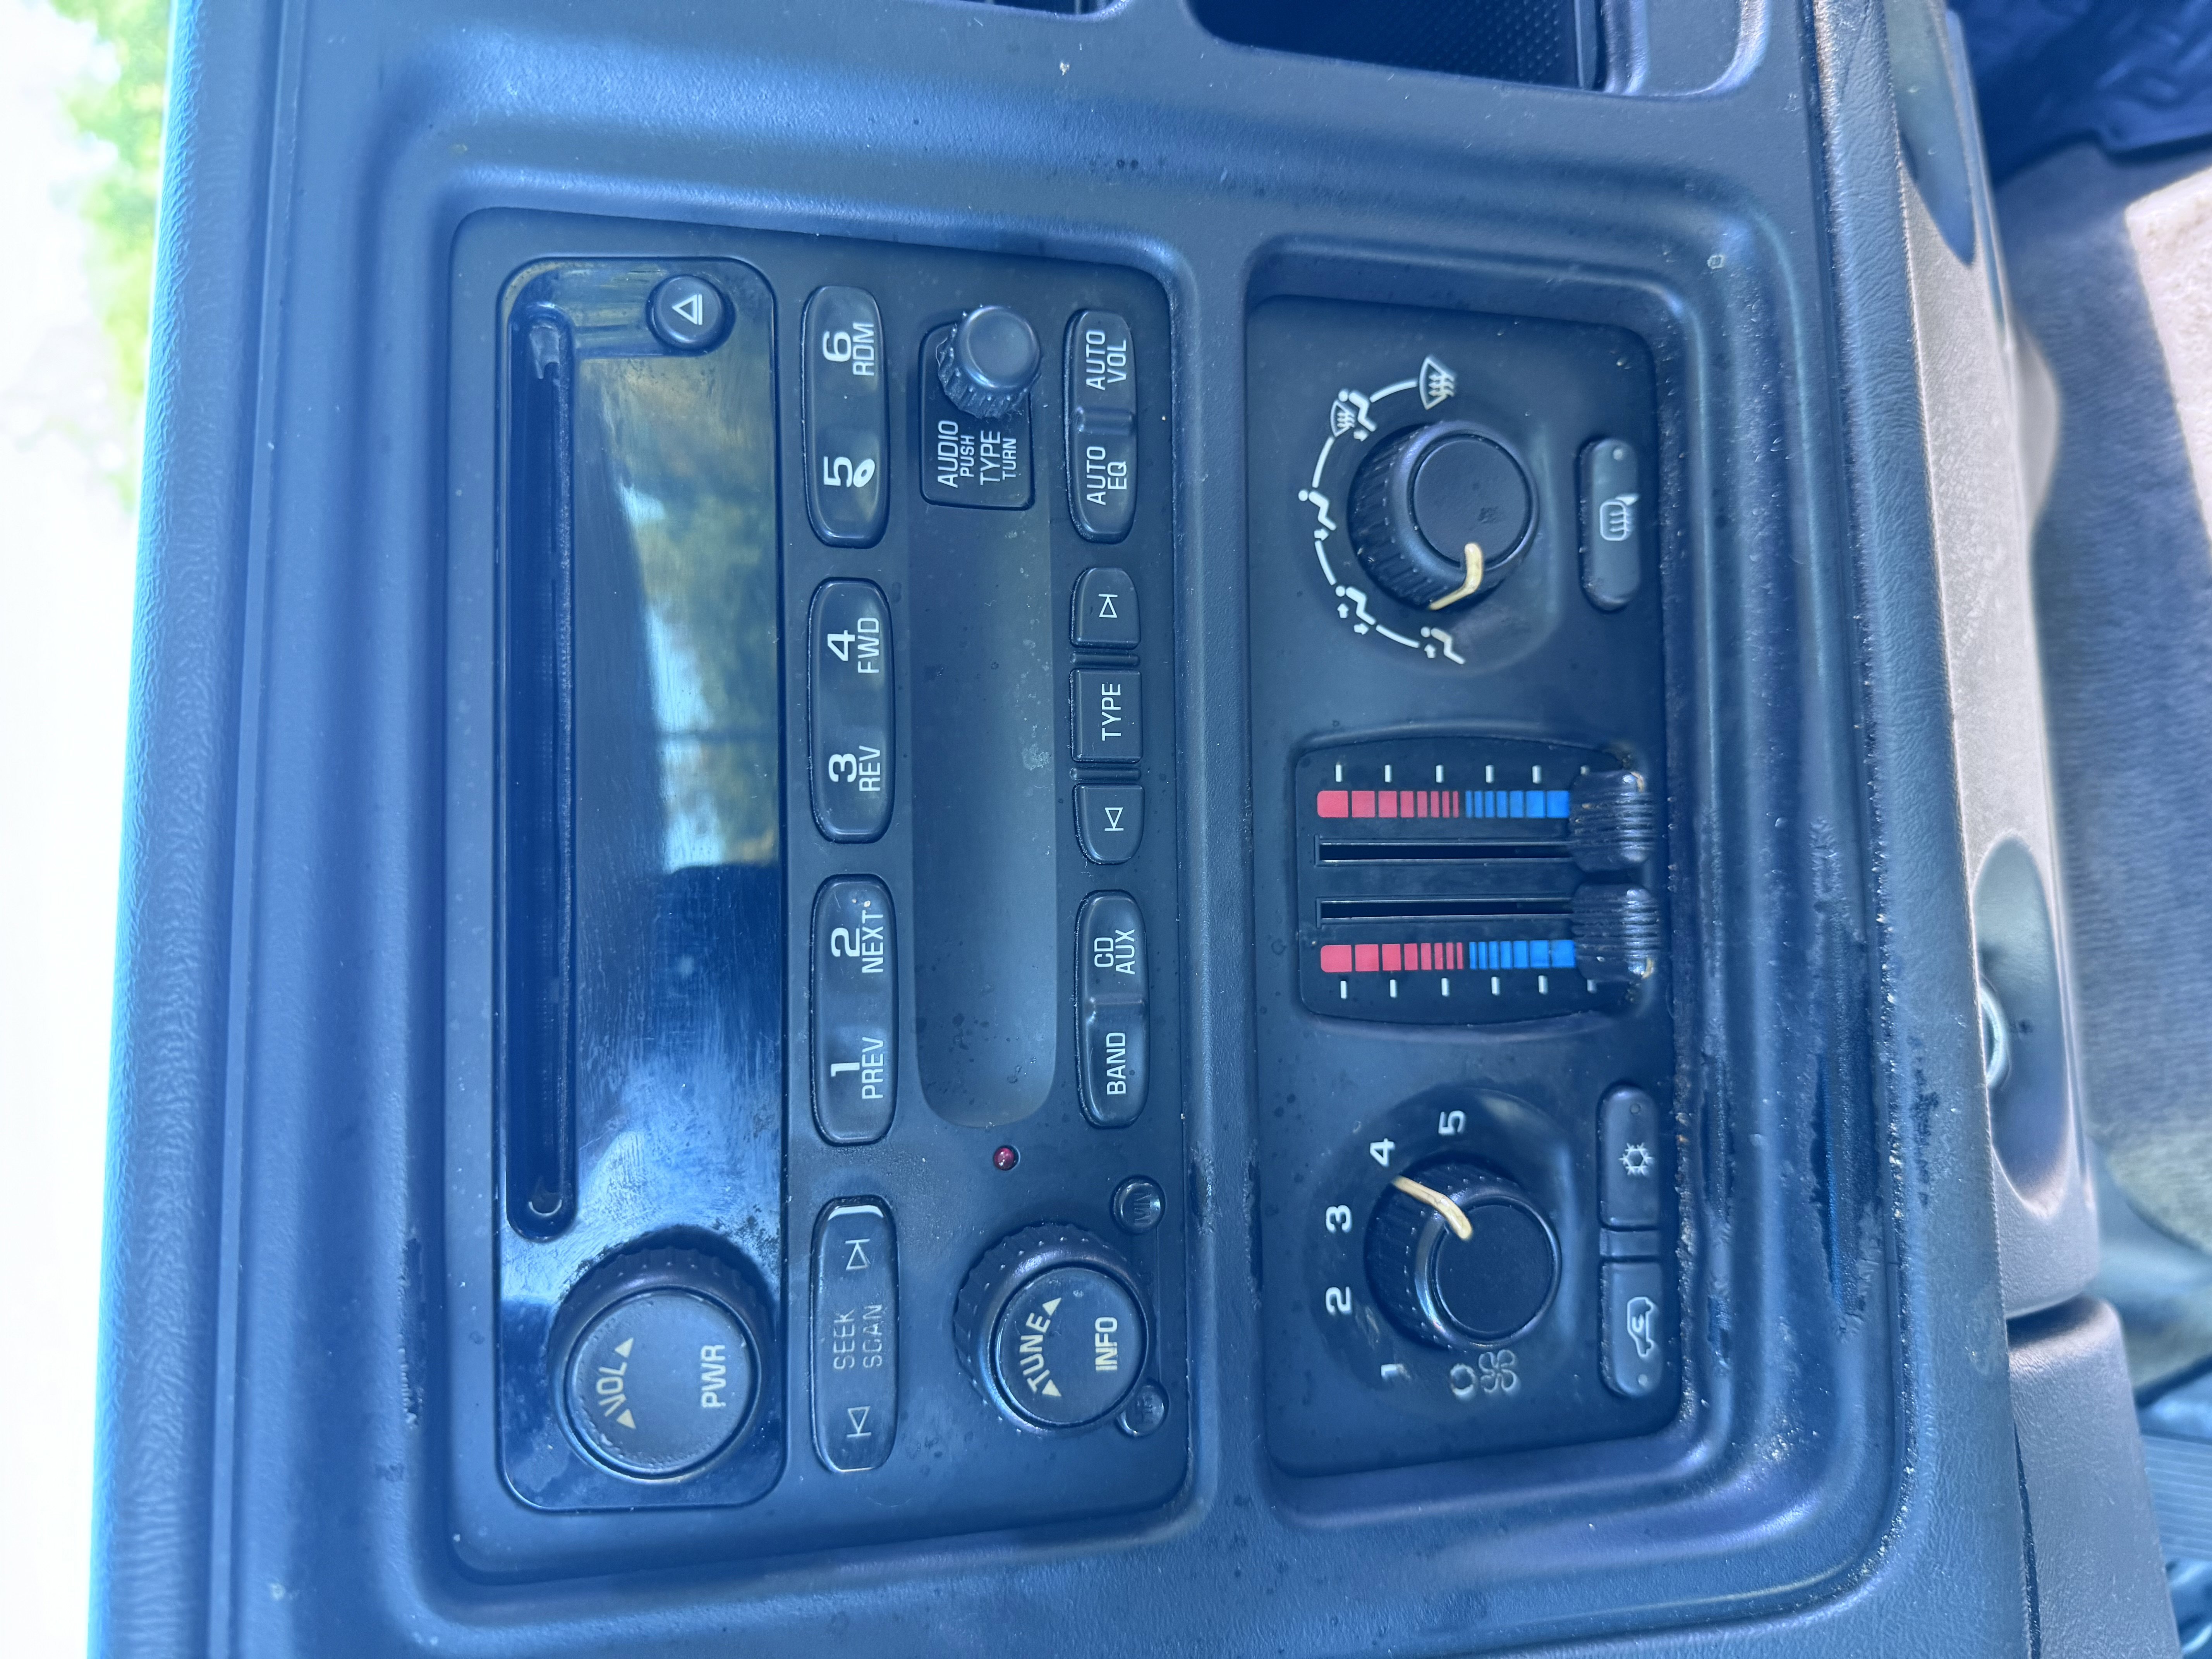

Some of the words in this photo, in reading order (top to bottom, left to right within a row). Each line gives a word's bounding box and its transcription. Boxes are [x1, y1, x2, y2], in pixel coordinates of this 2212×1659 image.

[823, 331, 851, 362] 6
[853, 322, 874, 376] RDM
[1086, 330, 1105, 390] AUTO
[1108, 338, 1126, 383] VOL
[824, 456, 852, 487] 5
[938, 420, 958, 488] AUDIO
[960, 435, 974, 477] PUSH
[981, 430, 1001, 485] TYPE
[1003, 438, 1016, 480] TURN
[1087, 446, 1106, 505] AUTO
[1108, 462, 1126, 490] EQ
[828, 630, 855, 661] 4
[858, 617, 879, 673] FWD
[1102, 684, 1121, 741] TYPE
[828, 753, 857, 783] 3
[859, 745, 880, 791] REV
[831, 927, 860, 957] 2
[862, 910, 883, 973] NEXT
[1094, 936, 1114, 968] CD
[1116, 929, 1135, 974] AUX
[831, 1062, 860, 1077] 1
[862, 1036, 884, 1099] PREV
[1107, 1032, 1126, 1095] BAND
[1438, 1110, 1465, 1135] 5
[1370, 1138, 1395, 1166] 4
[1325, 1204, 1352, 1233] 3
[1325, 1286, 1352, 1316] 2
[834, 1309, 855, 1370] SEEK
[863, 1304, 882, 1368] SCAN
[1020, 1312, 1051, 1394] TUNE
[1095, 1316, 1118, 1372] INFO
[596, 1362, 627, 1417] VOL
[701, 1345, 726, 1408] PWR
[1381, 1364, 1402, 1379] 1
